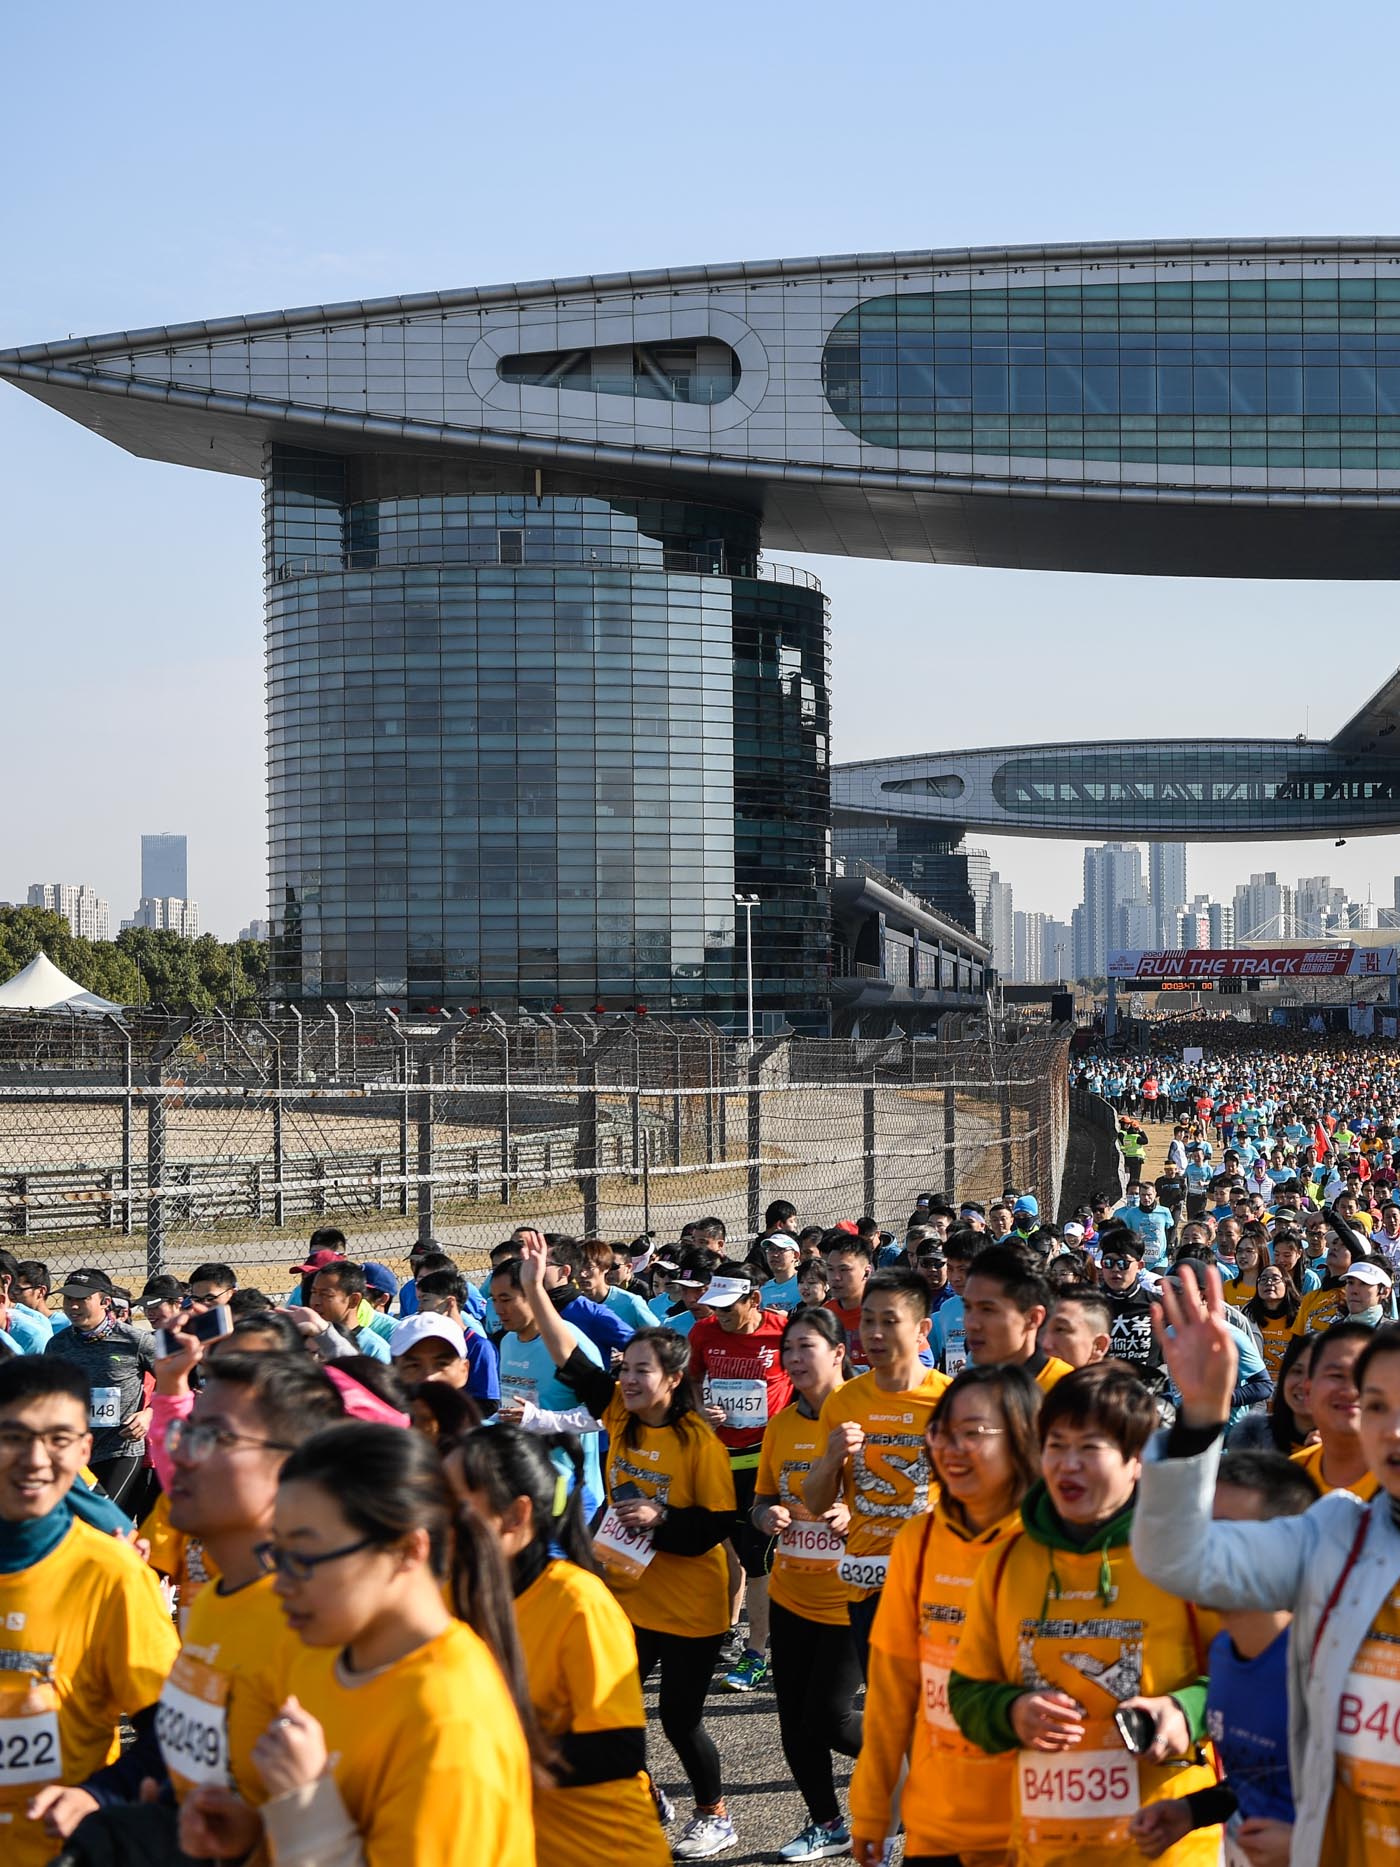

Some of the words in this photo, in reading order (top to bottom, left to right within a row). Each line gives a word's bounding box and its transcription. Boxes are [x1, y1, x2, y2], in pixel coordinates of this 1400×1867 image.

[1138, 959, 1184, 974] RUN
[1189, 959, 1226, 974] THE
[1232, 958, 1299, 974] TRACK
[1300, 963, 1335, 973] 迎新跑
[1201, 982, 1213, 990] 00
[1111, 1314, 1152, 1336] 大爷
[782, 1530, 842, 1551] B41668
[1024, 1766, 1130, 1802] B41535
